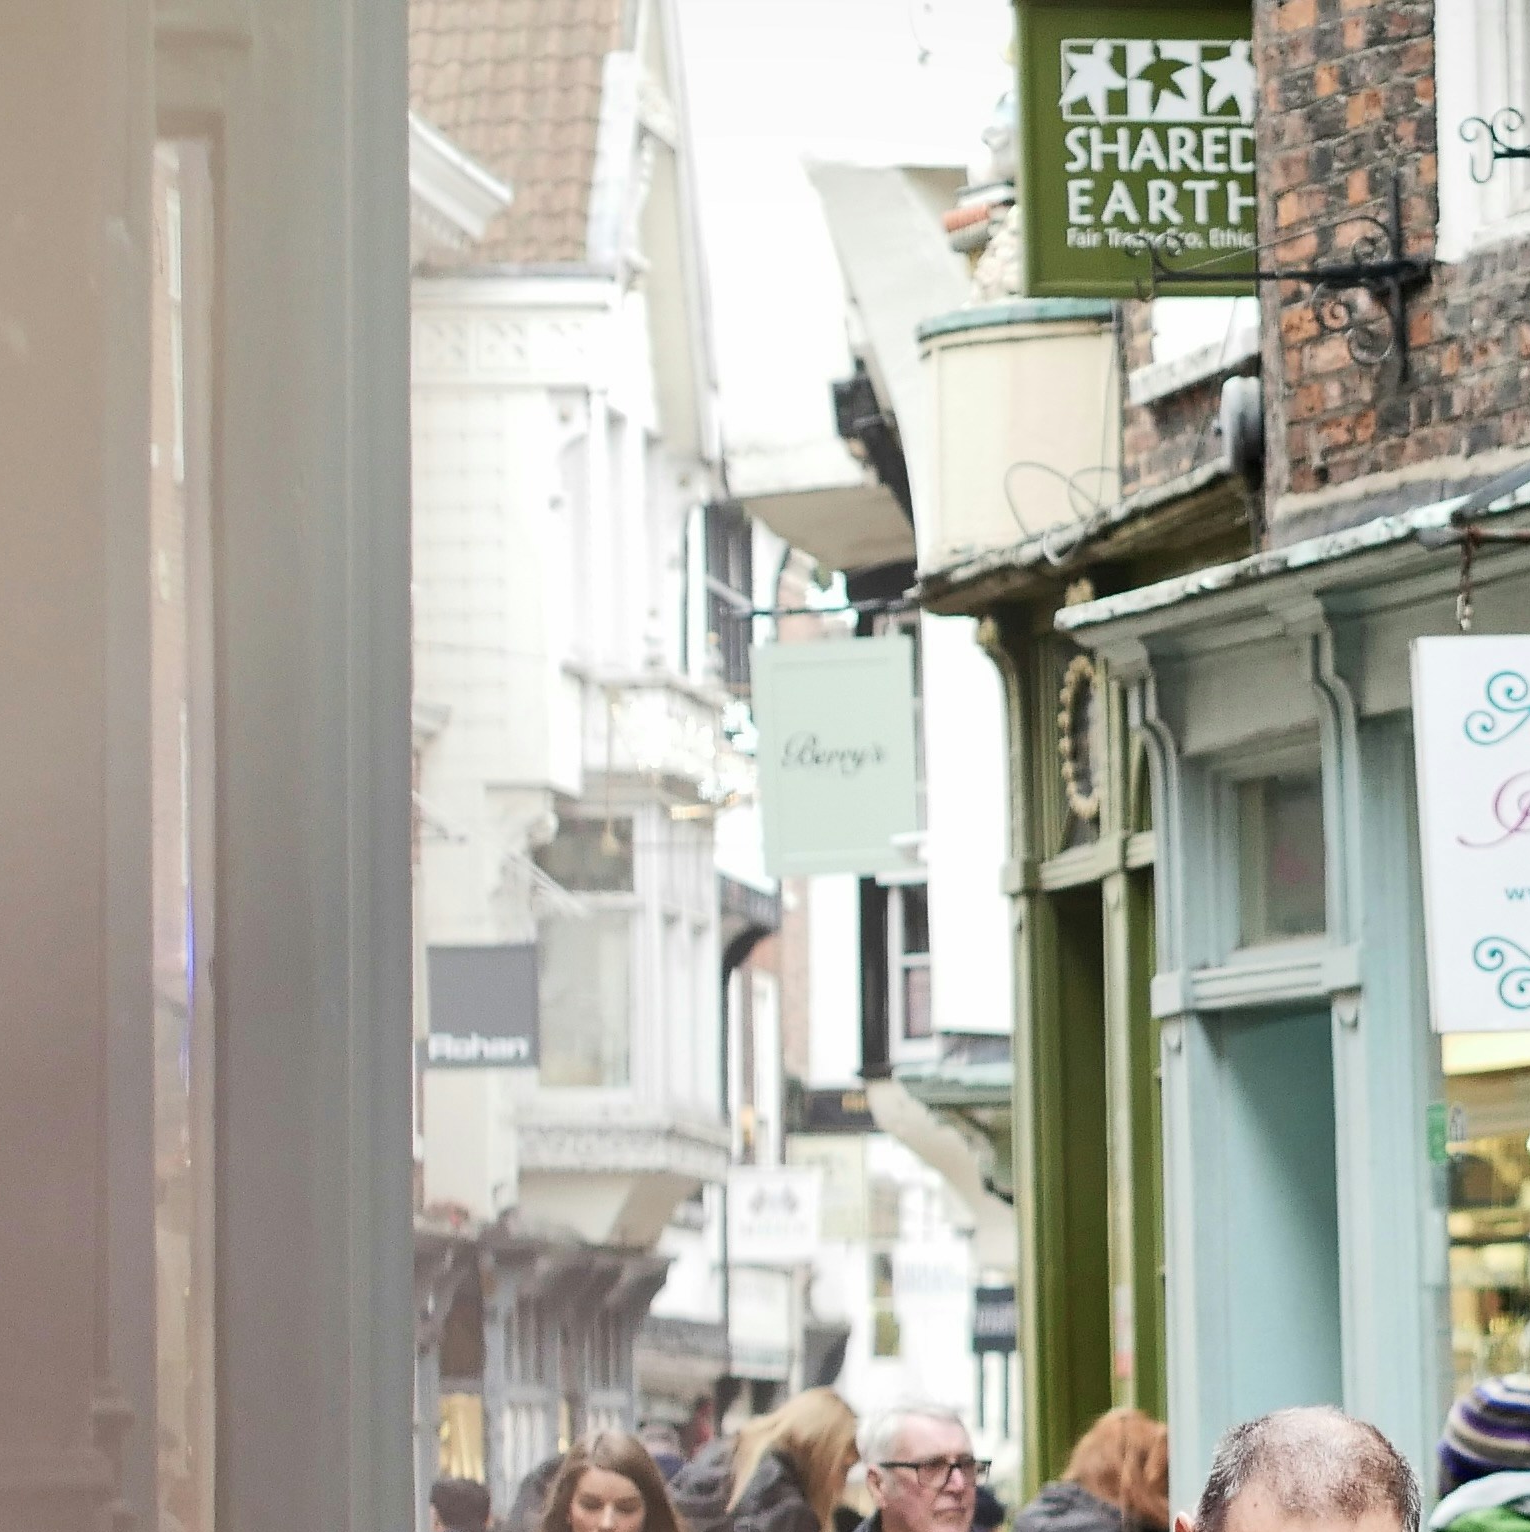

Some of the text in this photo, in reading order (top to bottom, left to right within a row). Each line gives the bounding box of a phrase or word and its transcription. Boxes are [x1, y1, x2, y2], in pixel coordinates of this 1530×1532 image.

[1064, 126, 1255, 173] SHARED
[1067, 178, 1255, 225] EARTH
[1066, 227, 1102, 249] Fair
